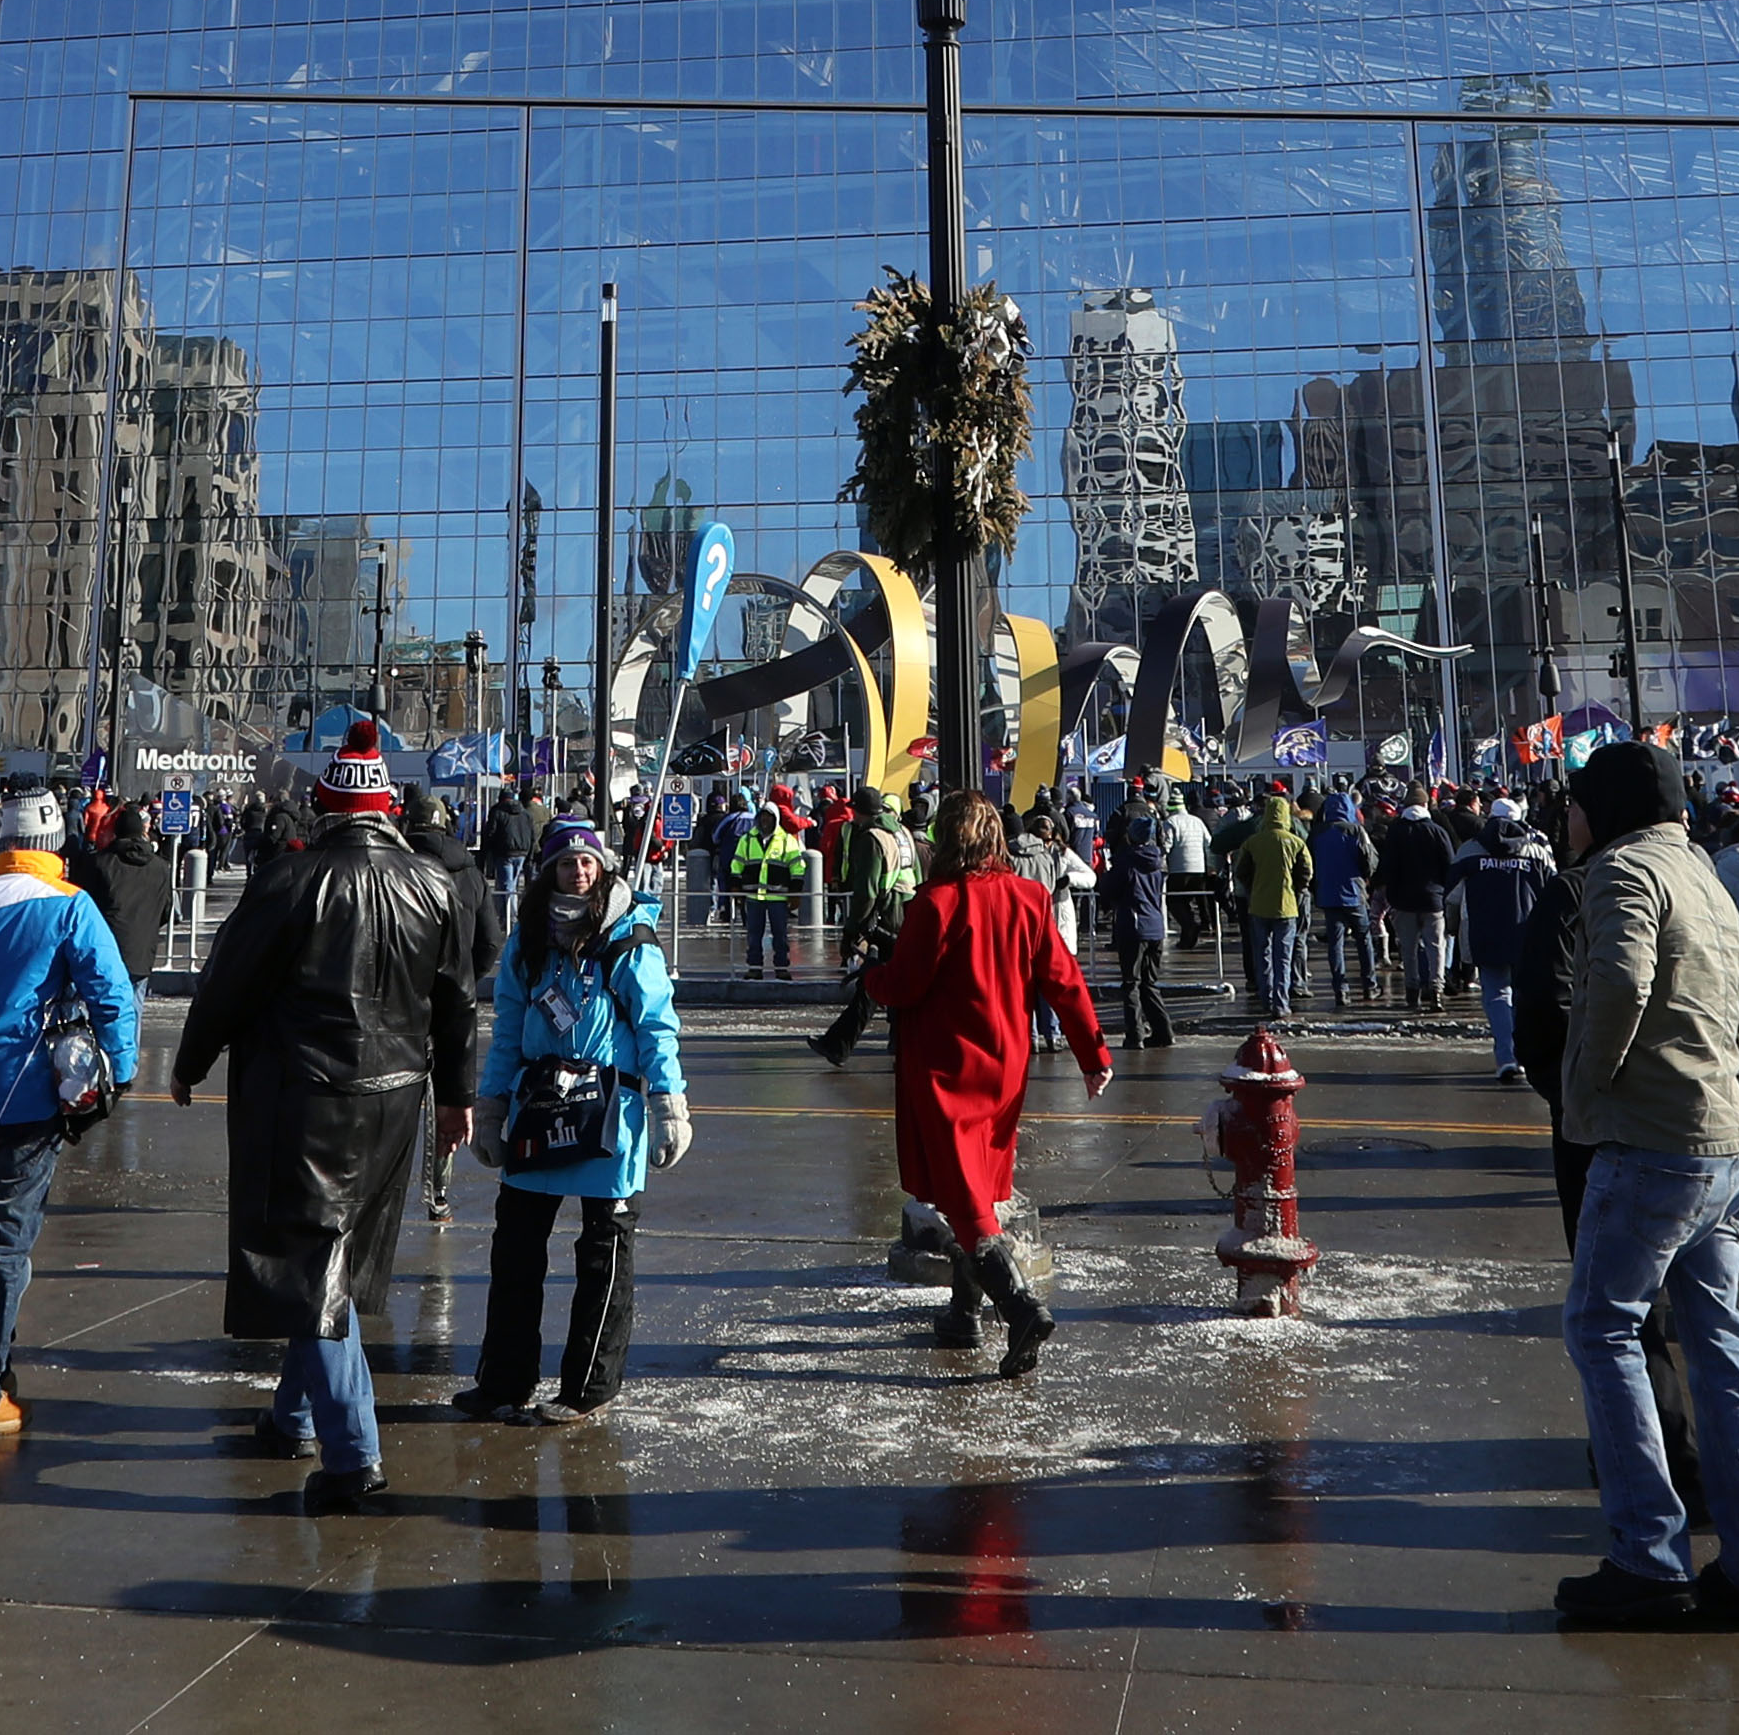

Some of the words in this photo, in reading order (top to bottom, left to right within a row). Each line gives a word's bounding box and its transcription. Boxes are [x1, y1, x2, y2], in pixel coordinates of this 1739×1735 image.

[135, 748, 257, 772] Medtronic
[215, 772, 256, 784] PLAZA
[1479, 857, 1531, 873] PATRIOTS
[564, 1090, 598, 1104] EAGLES
